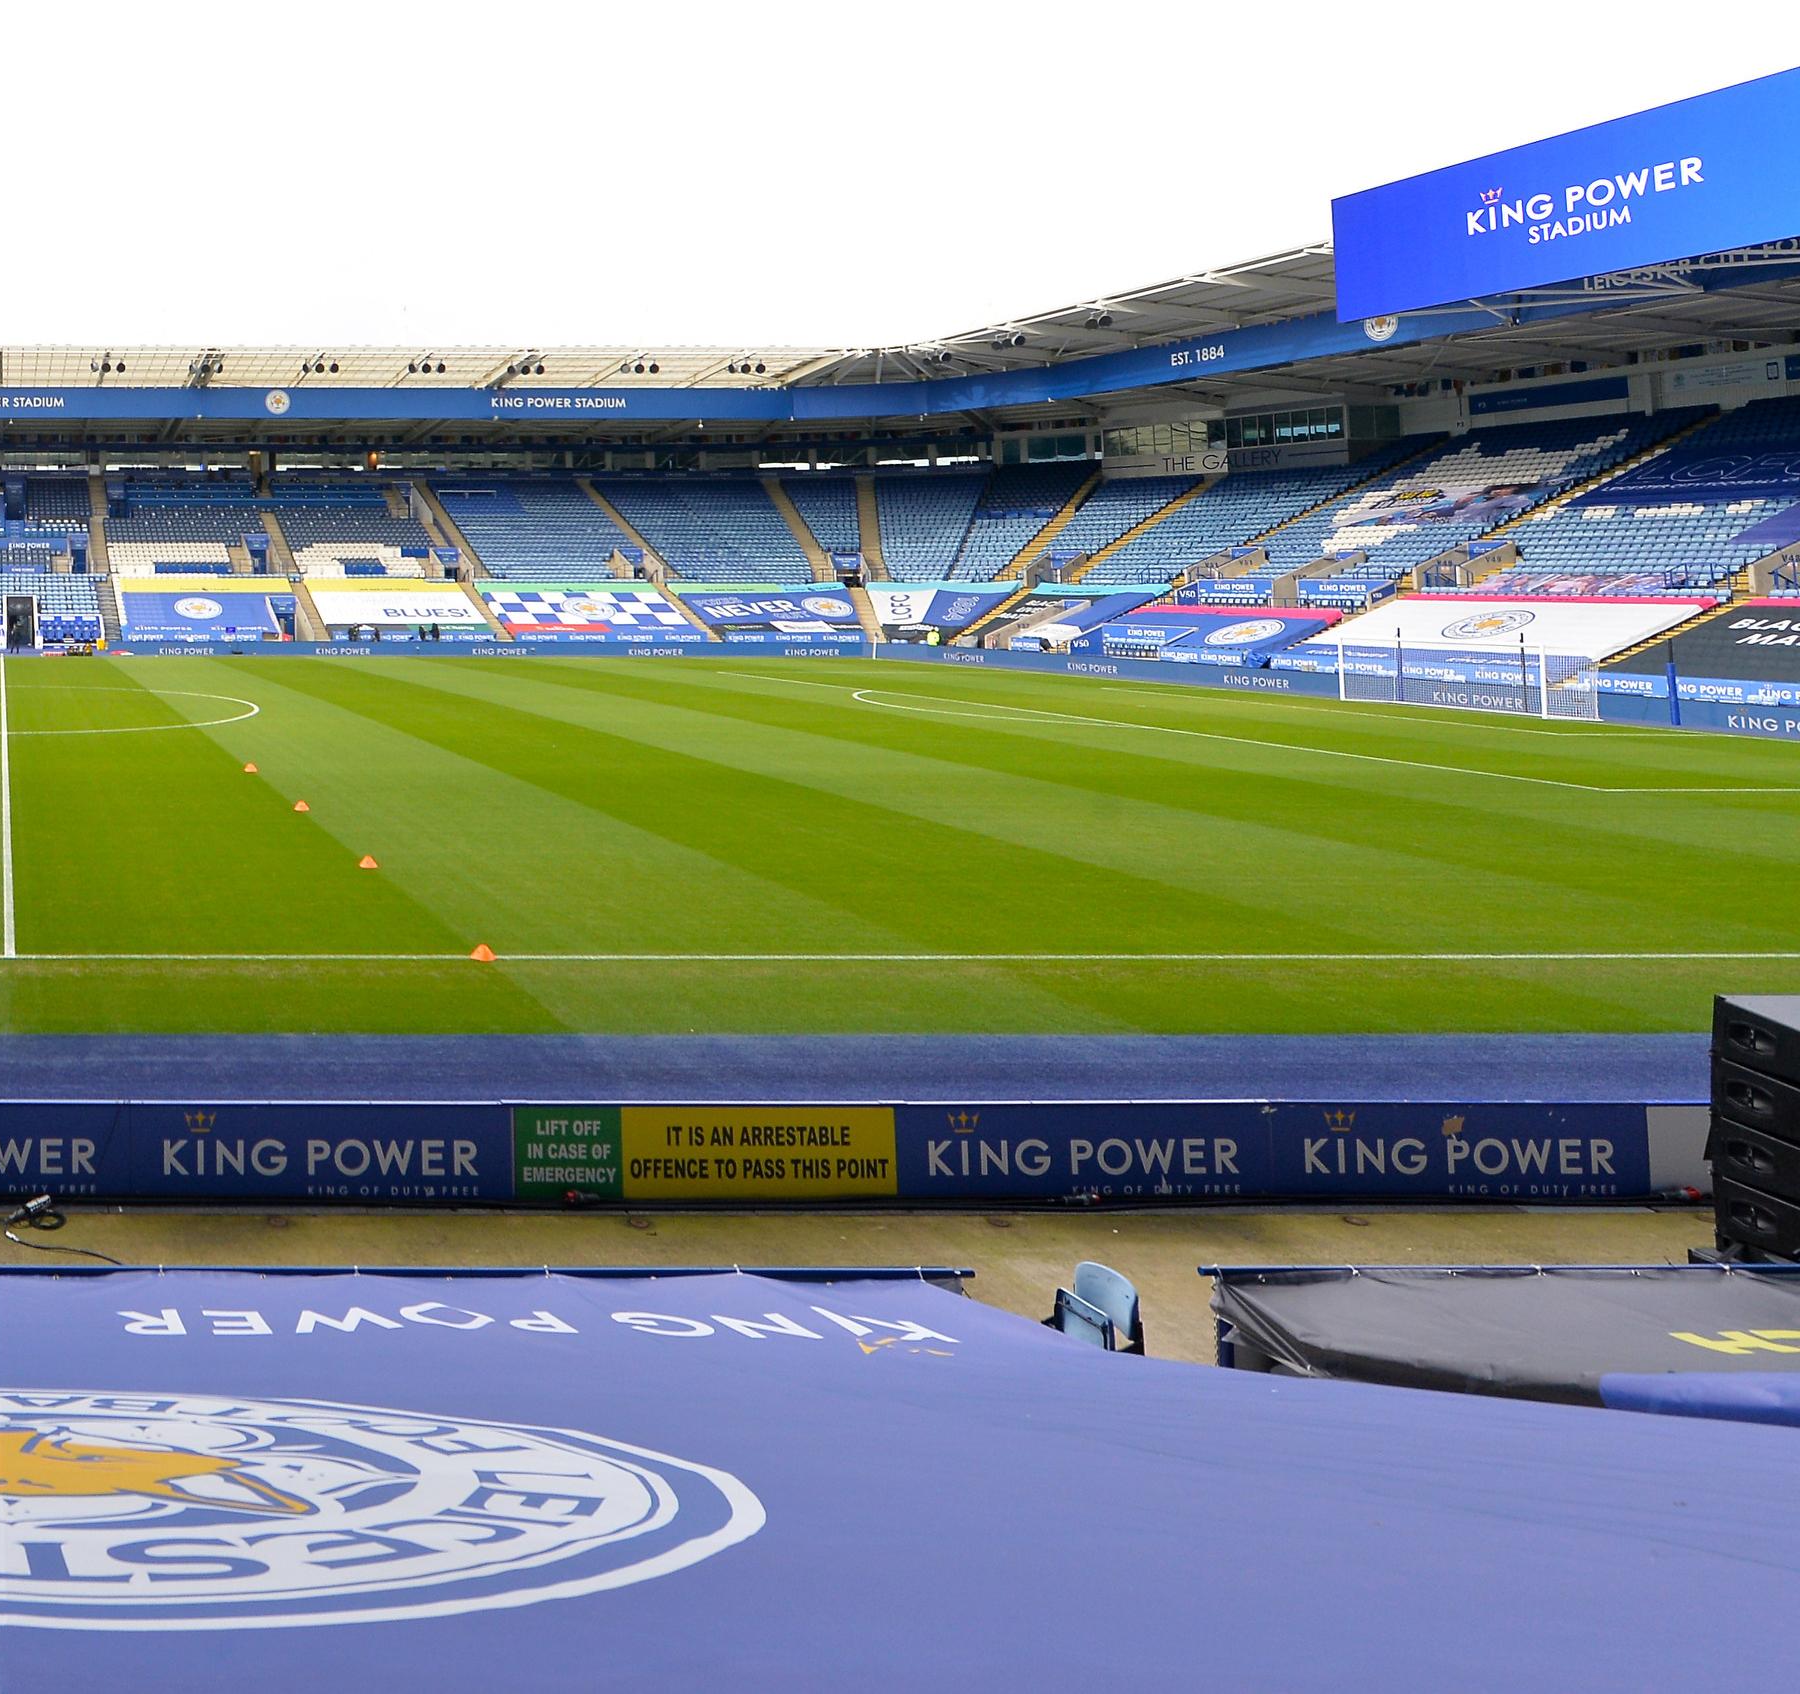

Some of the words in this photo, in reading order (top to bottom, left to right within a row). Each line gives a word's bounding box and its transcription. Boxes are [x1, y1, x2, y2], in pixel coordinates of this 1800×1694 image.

[1467, 193, 1551, 235] KING
[1566, 157, 1704, 213] POWER
[1528, 206, 1632, 244] STADIUM
[1171, 352, 1193, 366] EST.
[1197, 345, 1224, 362] 1884
[13, 396, 64, 407] STADIUM
[491, 397, 523, 408] KING
[527, 397, 571, 408] POWER
[575, 397, 626, 408] STADIUM
[1162, 456, 1195, 473] THE
[1202, 450, 1282, 471] GALLERY
[383, 608, 472, 618] BLUES!
[702, 600, 800, 618] NEVER
[891, 594, 910, 621] LCFC
[472, 648, 496, 656] KING
[498, 648, 527, 656] POWER
[1067, 663, 1087, 671] KING
[1090, 664, 1117, 674] POWER
[1224, 675, 1249, 685] KING
[1253, 678, 1289, 688] POWER
[1614, 680, 1653, 690] POWER
[1700, 686, 1743, 696] POWER
[1433, 692, 1468, 704] KING
[1473, 696, 1522, 708] POWER
[1728, 715, 1779, 731] KING
[537, 1120, 568, 1136] LIFT
[573, 1121, 601, 1136] OFF
[667, 1126, 683, 1146] IT
[688, 1126, 704, 1146] IS
[710, 1126, 734, 1146] AN
[740, 1126, 851, 1147] ARRESTABLE
[163, 1139, 288, 1177] KING
[308, 1139, 479, 1176] POWER
[527, 1144, 543, 1159] IN
[548, 1144, 587, 1159] CASE
[592, 1144, 611, 1159] OF
[927, 1139, 1051, 1177] KING
[1070, 1138, 1239, 1175] POWER
[1304, 1138, 1428, 1175] KING
[1447, 1138, 1616, 1175] POWER
[523, 1167, 616, 1183] EMERGENCY
[630, 1159, 710, 1180] OFFENCE
[714, 1159, 737, 1179] TO
[743, 1159, 785, 1179] PASS
[791, 1159, 831, 1179] THIS
[837, 1159, 889, 1180] POINT
[308, 1186, 347, 1196] KING
[361, 1186, 380, 1196] OF
[392, 1186, 435, 1196] DUTY
[442, 1186, 480, 1196] FREE
[1448, 1184, 1488, 1193] KING
[1500, 1184, 1521, 1193] OF
[1531, 1184, 1569, 1194] DUTY
[1581, 1184, 1616, 1194] FREE
[115, 1301, 580, 1336] POWER
[611, 1305, 961, 1343] KING
